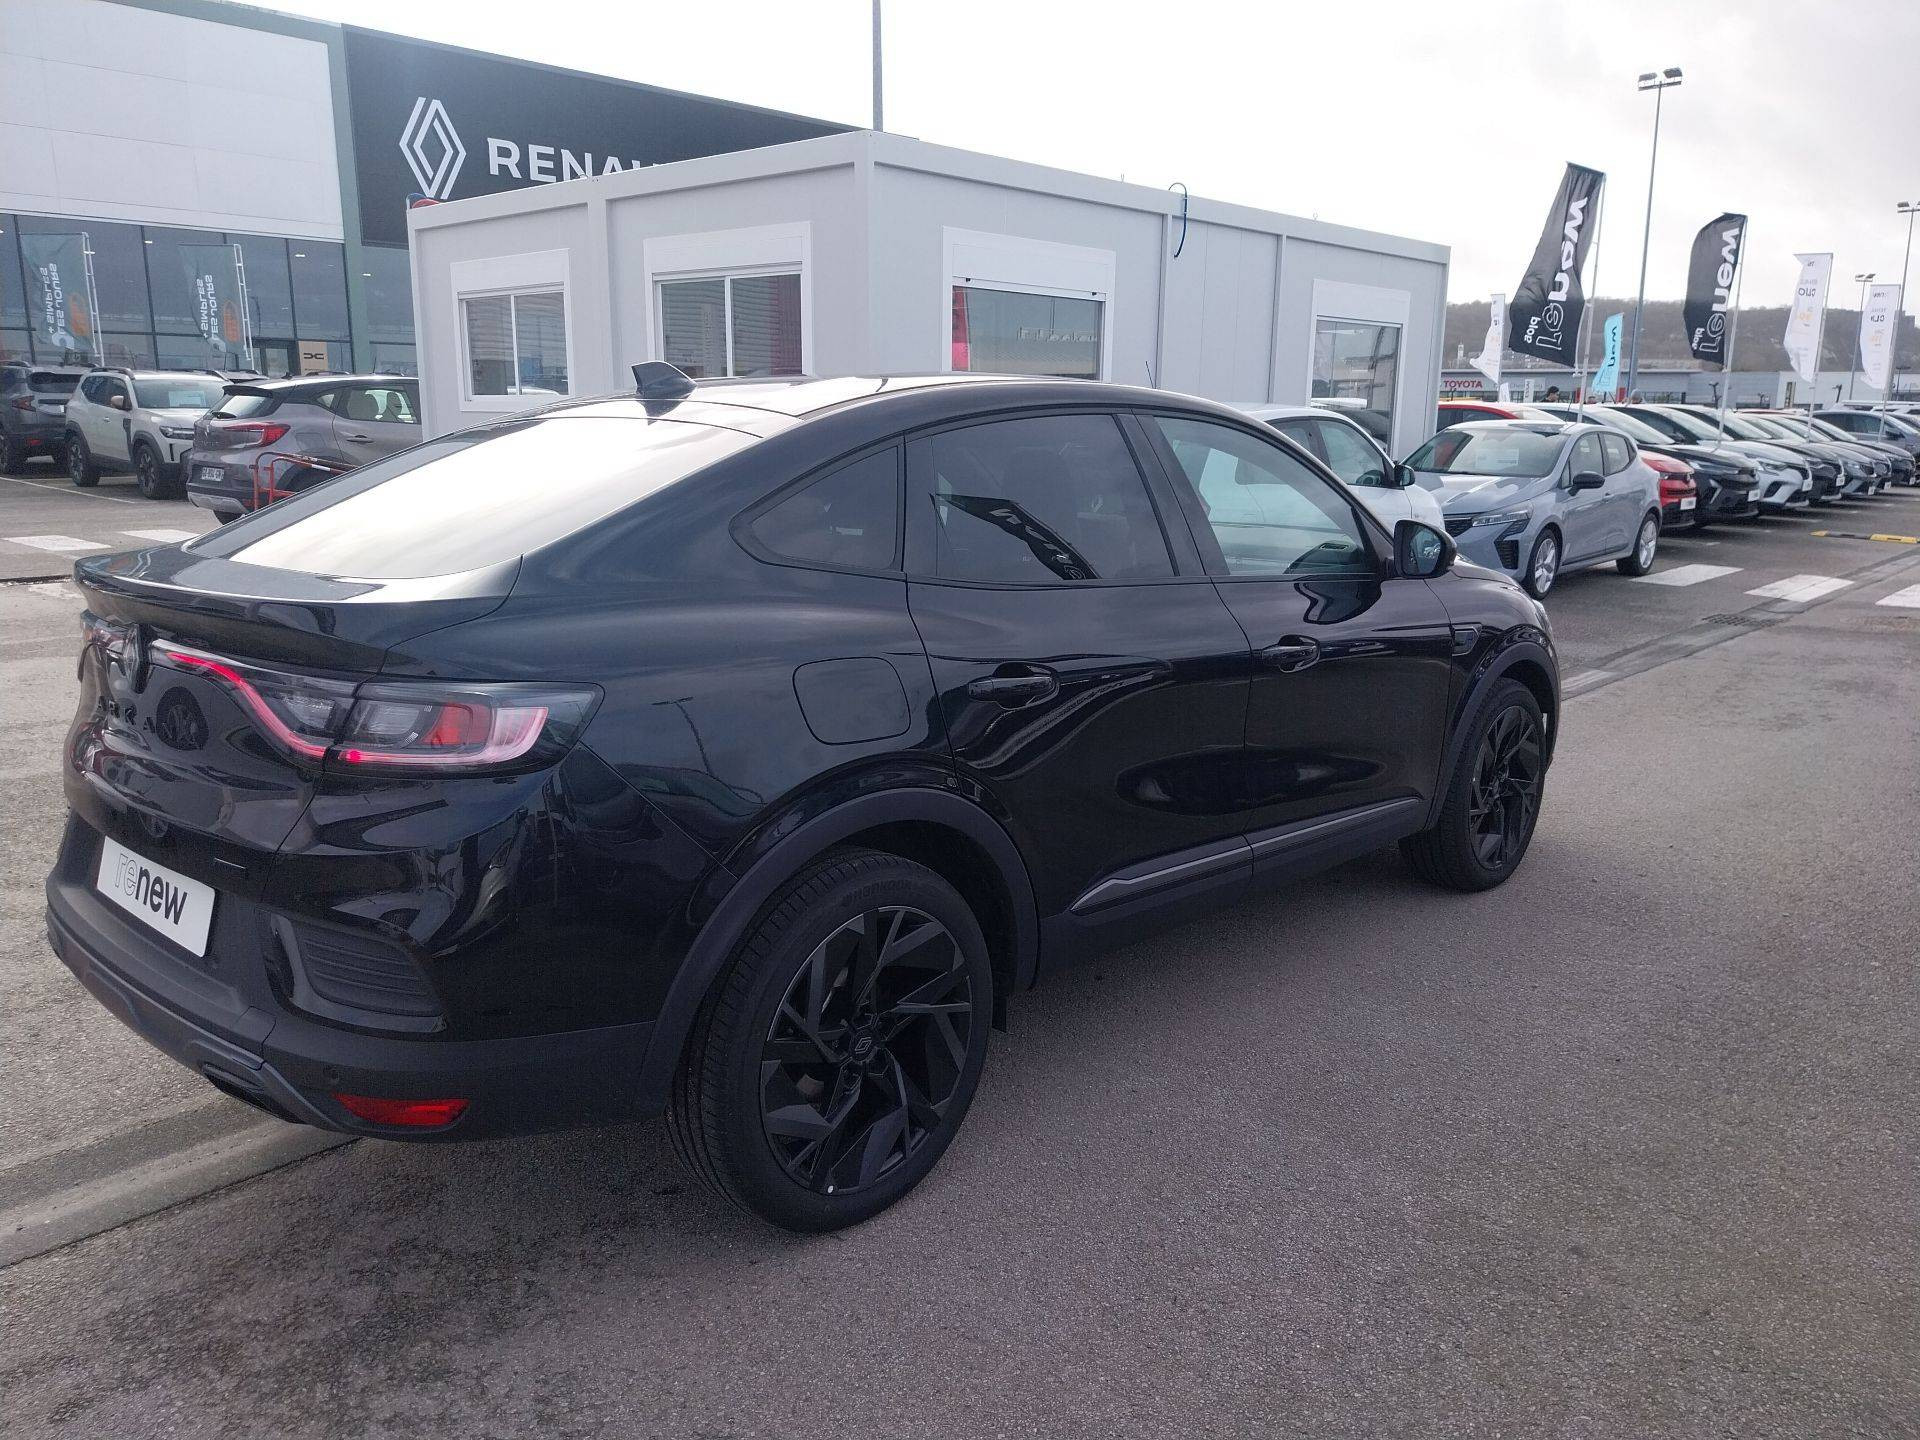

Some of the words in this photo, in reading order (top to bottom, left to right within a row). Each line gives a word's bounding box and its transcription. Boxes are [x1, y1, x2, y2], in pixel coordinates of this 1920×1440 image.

[487, 137, 661, 183] RENA
[1443, 380, 1483, 388] TOYOTA
[115, 853, 188, 926] renew
